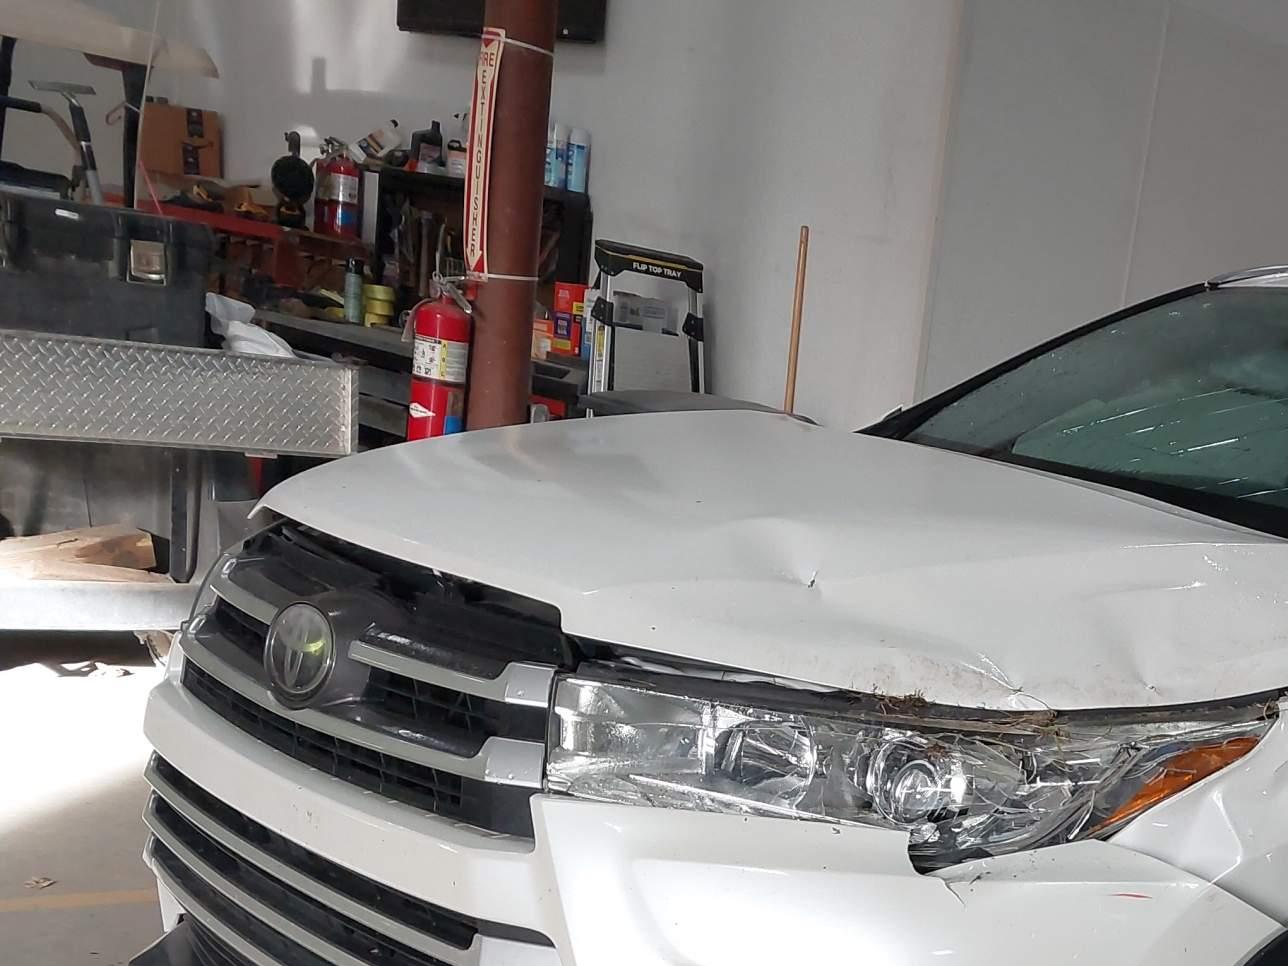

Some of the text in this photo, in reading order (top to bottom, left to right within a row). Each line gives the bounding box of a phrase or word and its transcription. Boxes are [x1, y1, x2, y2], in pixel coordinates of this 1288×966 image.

[470, 70, 487, 257] EXTINGUISHER
[632, 262, 682, 278] FLIP TOP TRAY
